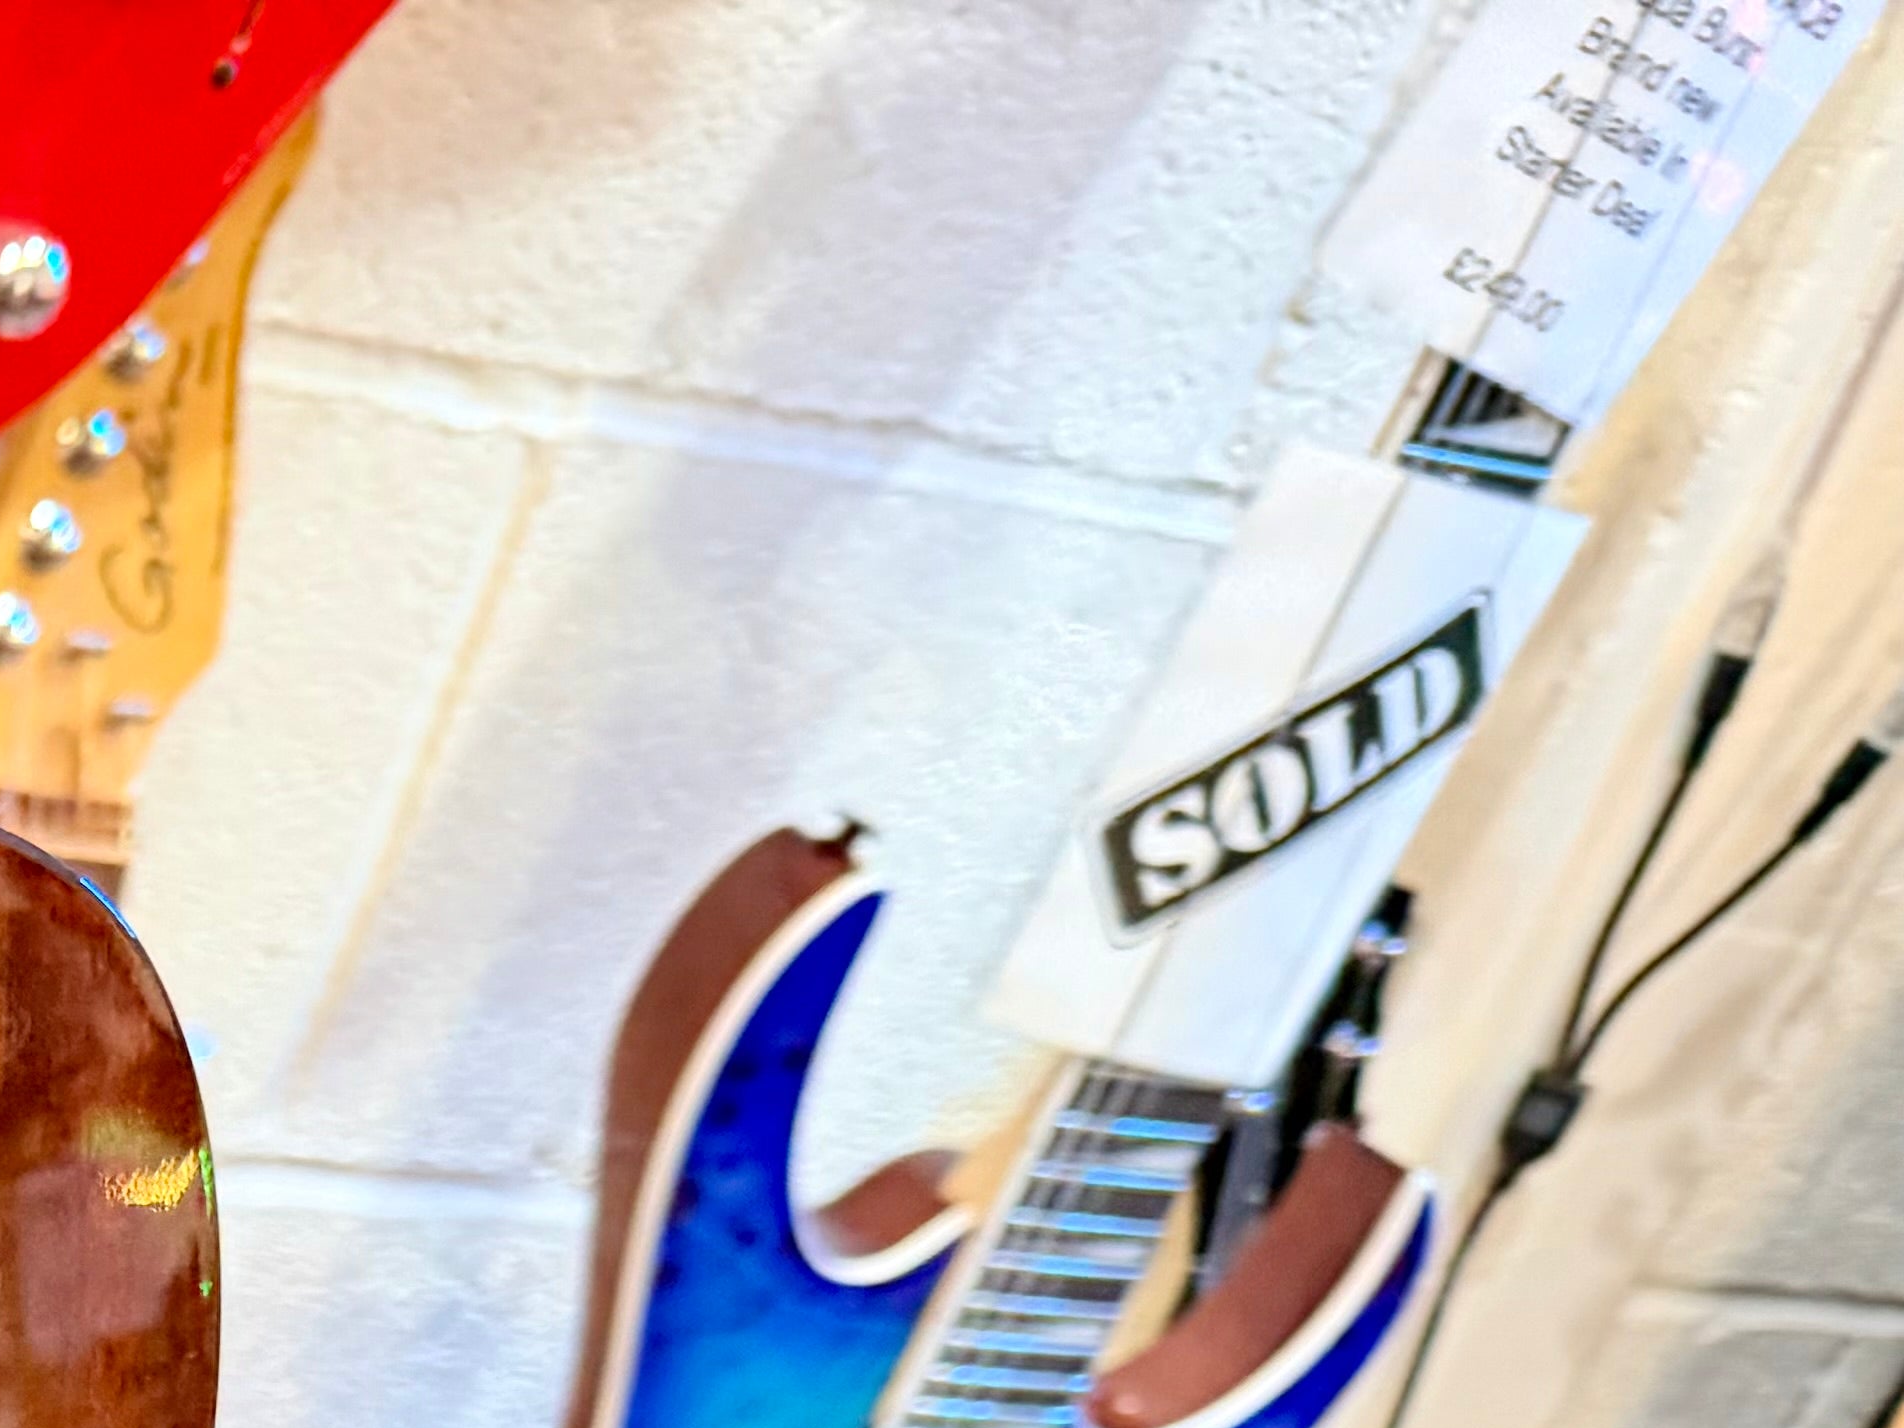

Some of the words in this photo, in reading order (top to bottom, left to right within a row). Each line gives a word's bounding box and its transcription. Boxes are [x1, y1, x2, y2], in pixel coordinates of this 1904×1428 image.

[1576, 15, 1677, 93] Brand
[1534, 72, 1663, 168] Available
[1495, 124, 1596, 201] Starter
[1591, 180, 1664, 239] Deal
[1442, 247, 1565, 333] £249.00
[1129, 646, 1463, 908] SOLD
